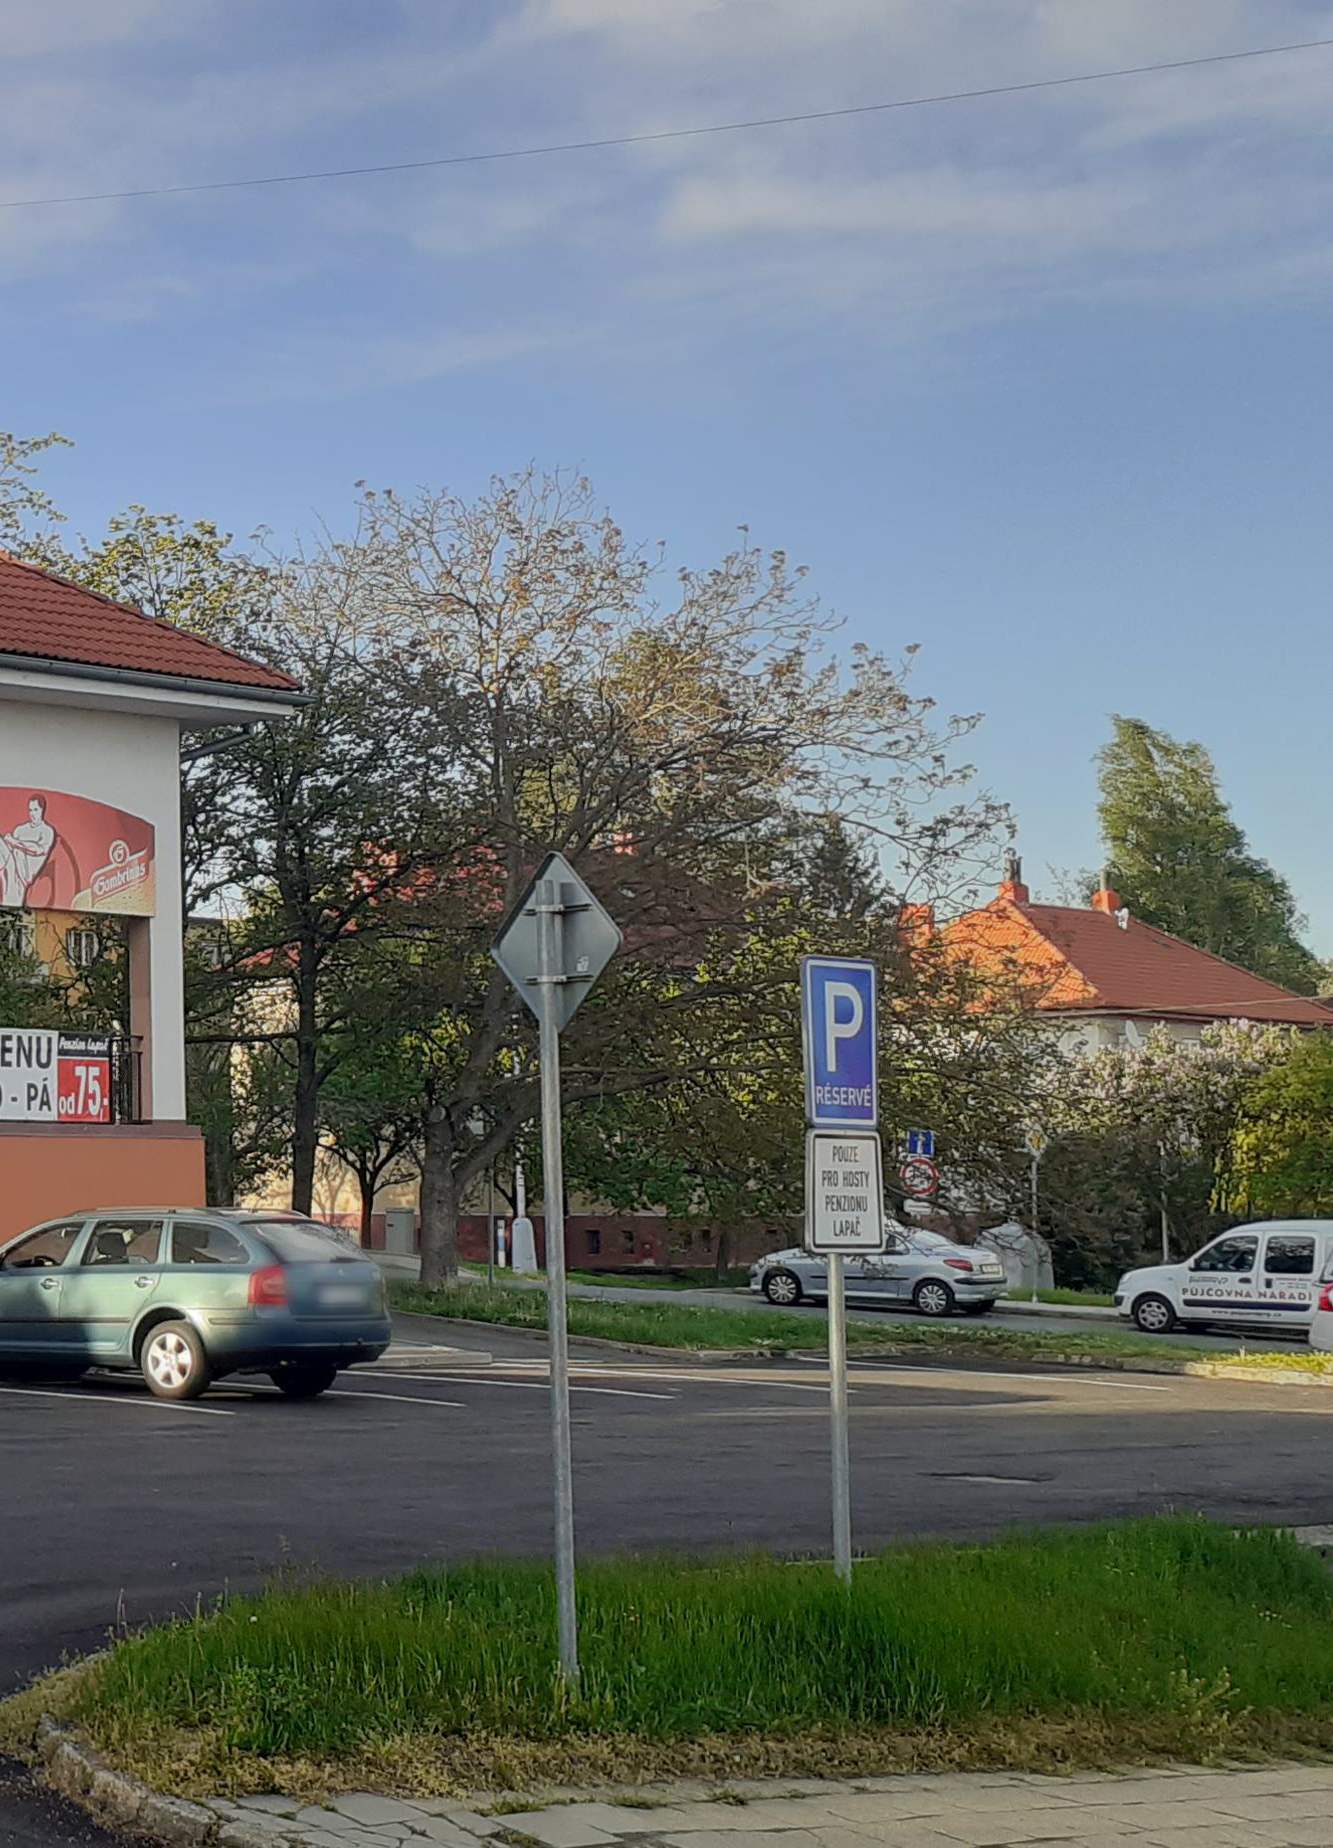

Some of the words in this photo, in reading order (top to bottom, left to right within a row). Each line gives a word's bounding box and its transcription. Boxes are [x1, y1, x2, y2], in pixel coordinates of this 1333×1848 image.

[93, 863, 146, 896] Gambrinus
[824, 981, 864, 1072] P
[27, 1077, 52, 1112] PÁ
[59, 1092, 75, 1115] od
[816, 1082, 872, 1107] RÉSERVÉ
[832, 1145, 860, 1162] POUZE
[821, 1170, 839, 1188] PRO
[842, 1170, 870, 1188] HOSTY
[825, 1195, 868, 1212] PENZIONU
[833, 1217, 861, 1237] LAPAČ
